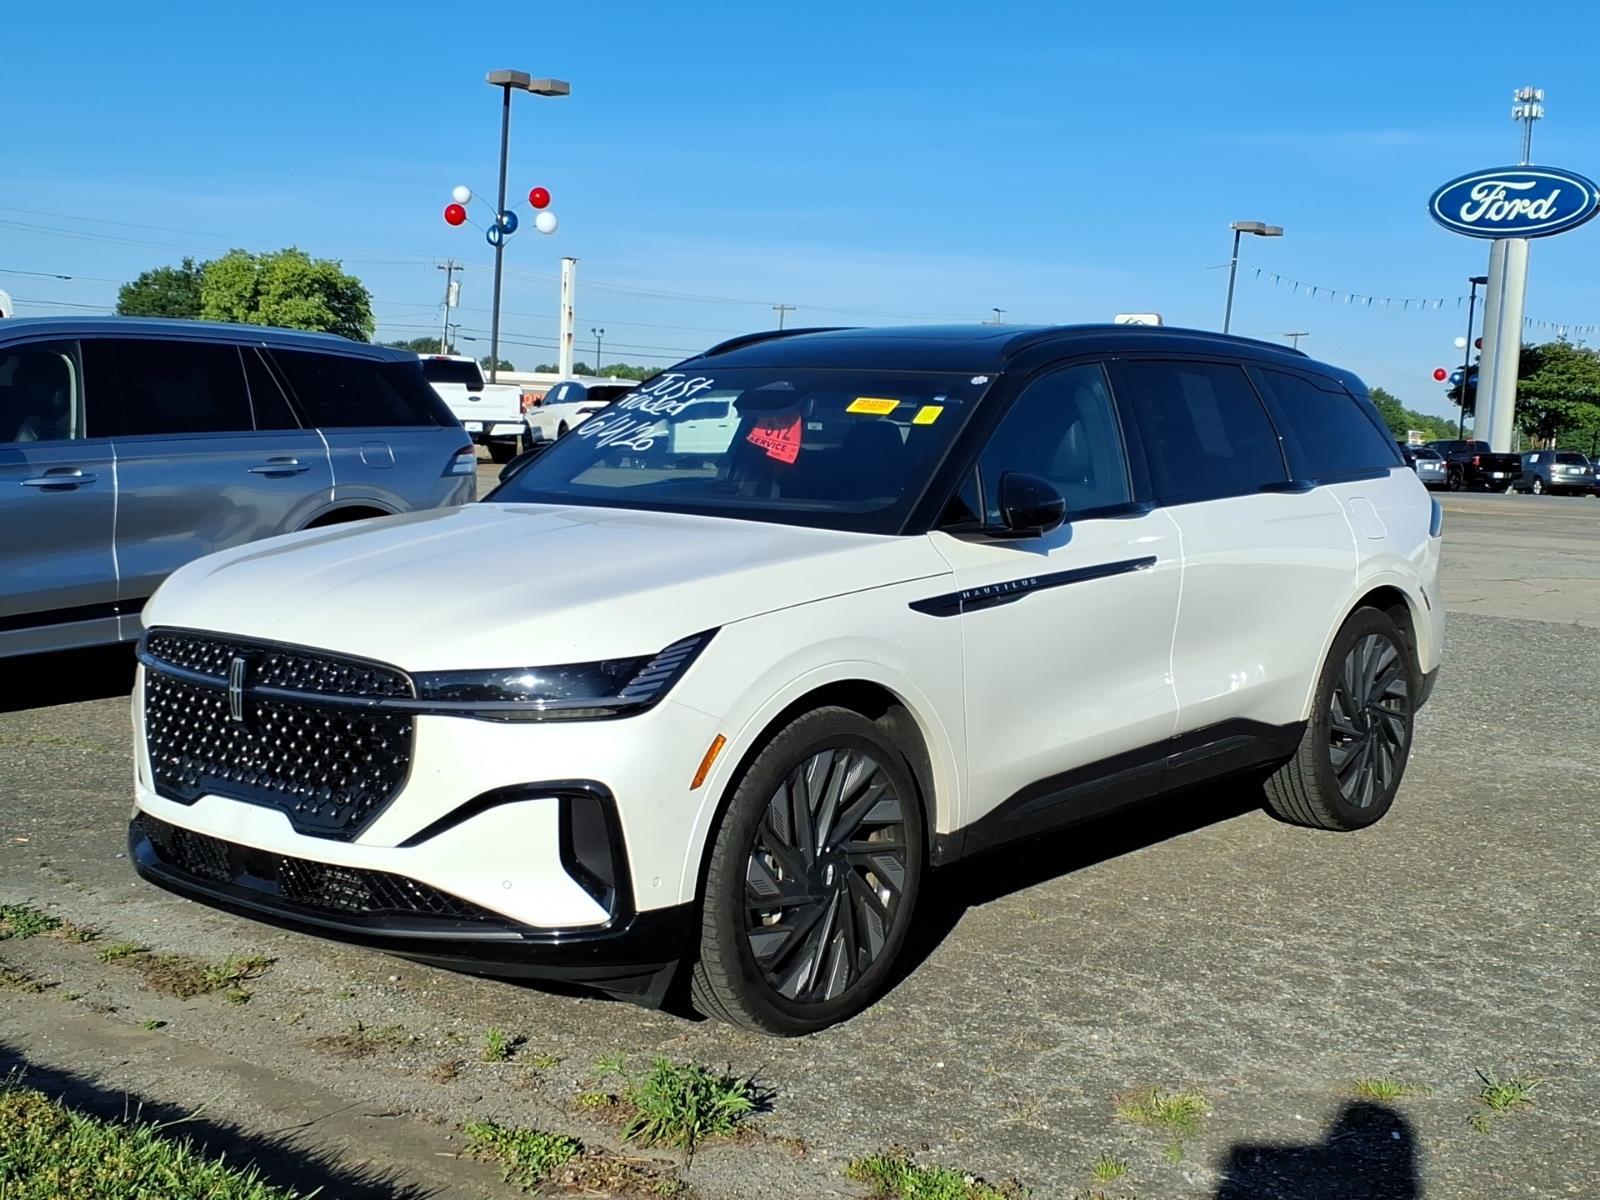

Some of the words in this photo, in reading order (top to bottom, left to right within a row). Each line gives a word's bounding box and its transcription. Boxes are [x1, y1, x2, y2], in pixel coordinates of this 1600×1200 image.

[1460, 181, 1561, 222] Ford
[750, 436, 788, 453] SERVICE
[962, 578, 1037, 599] NAUTILUS
